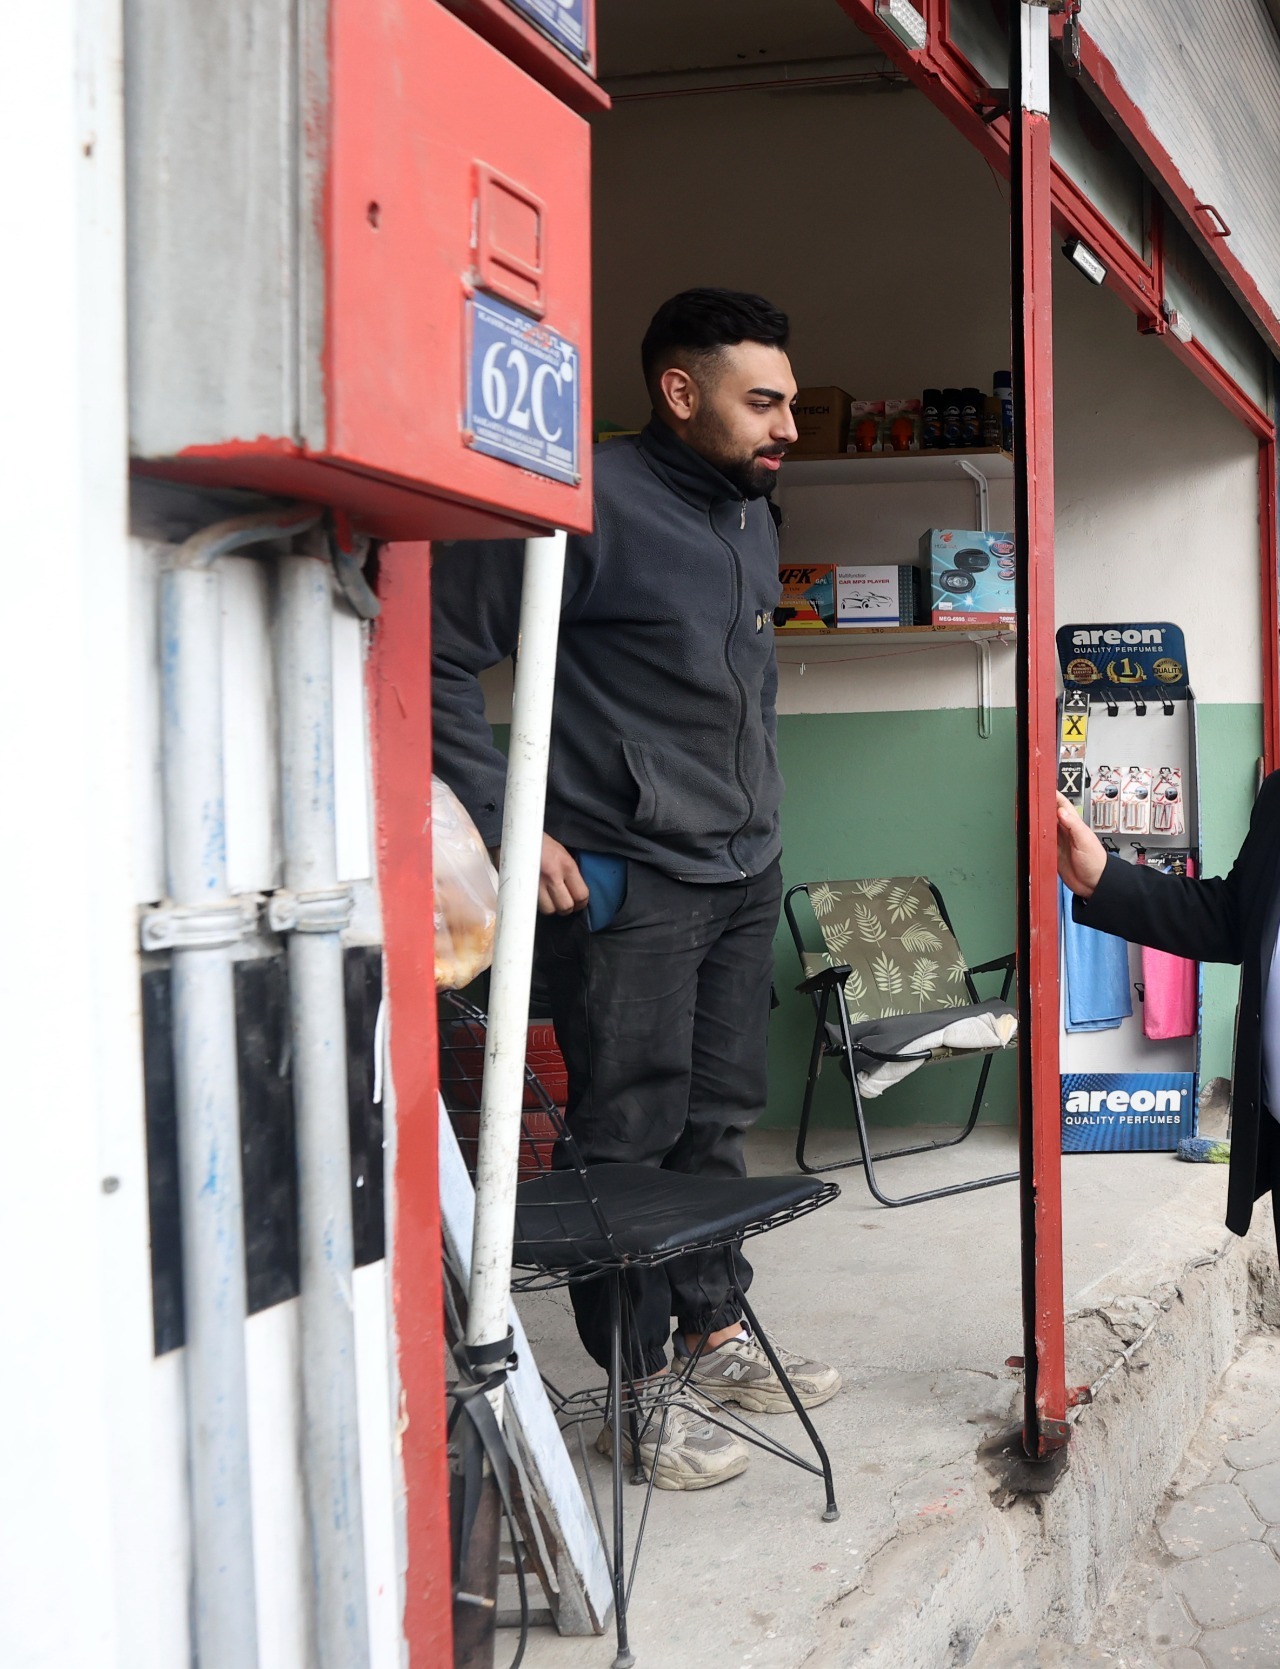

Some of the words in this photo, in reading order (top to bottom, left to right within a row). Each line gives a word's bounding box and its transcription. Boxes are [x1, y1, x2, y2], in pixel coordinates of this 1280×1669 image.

[481, 342, 563, 443] 62C
[1073, 646, 1112, 654] QUALITY
[1115, 645, 1164, 653] PERFUMES
[1121, 657, 1133, 675] 1
[1153, 666, 1183, 674] QUALITY
[1060, 771, 1080, 793] X
[1065, 1089, 1181, 1113] areon
[1065, 1116, 1114, 1125] QUALITY
[1119, 1115, 1181, 1124] PERFUMES
[722, 1361, 751, 1381] N
